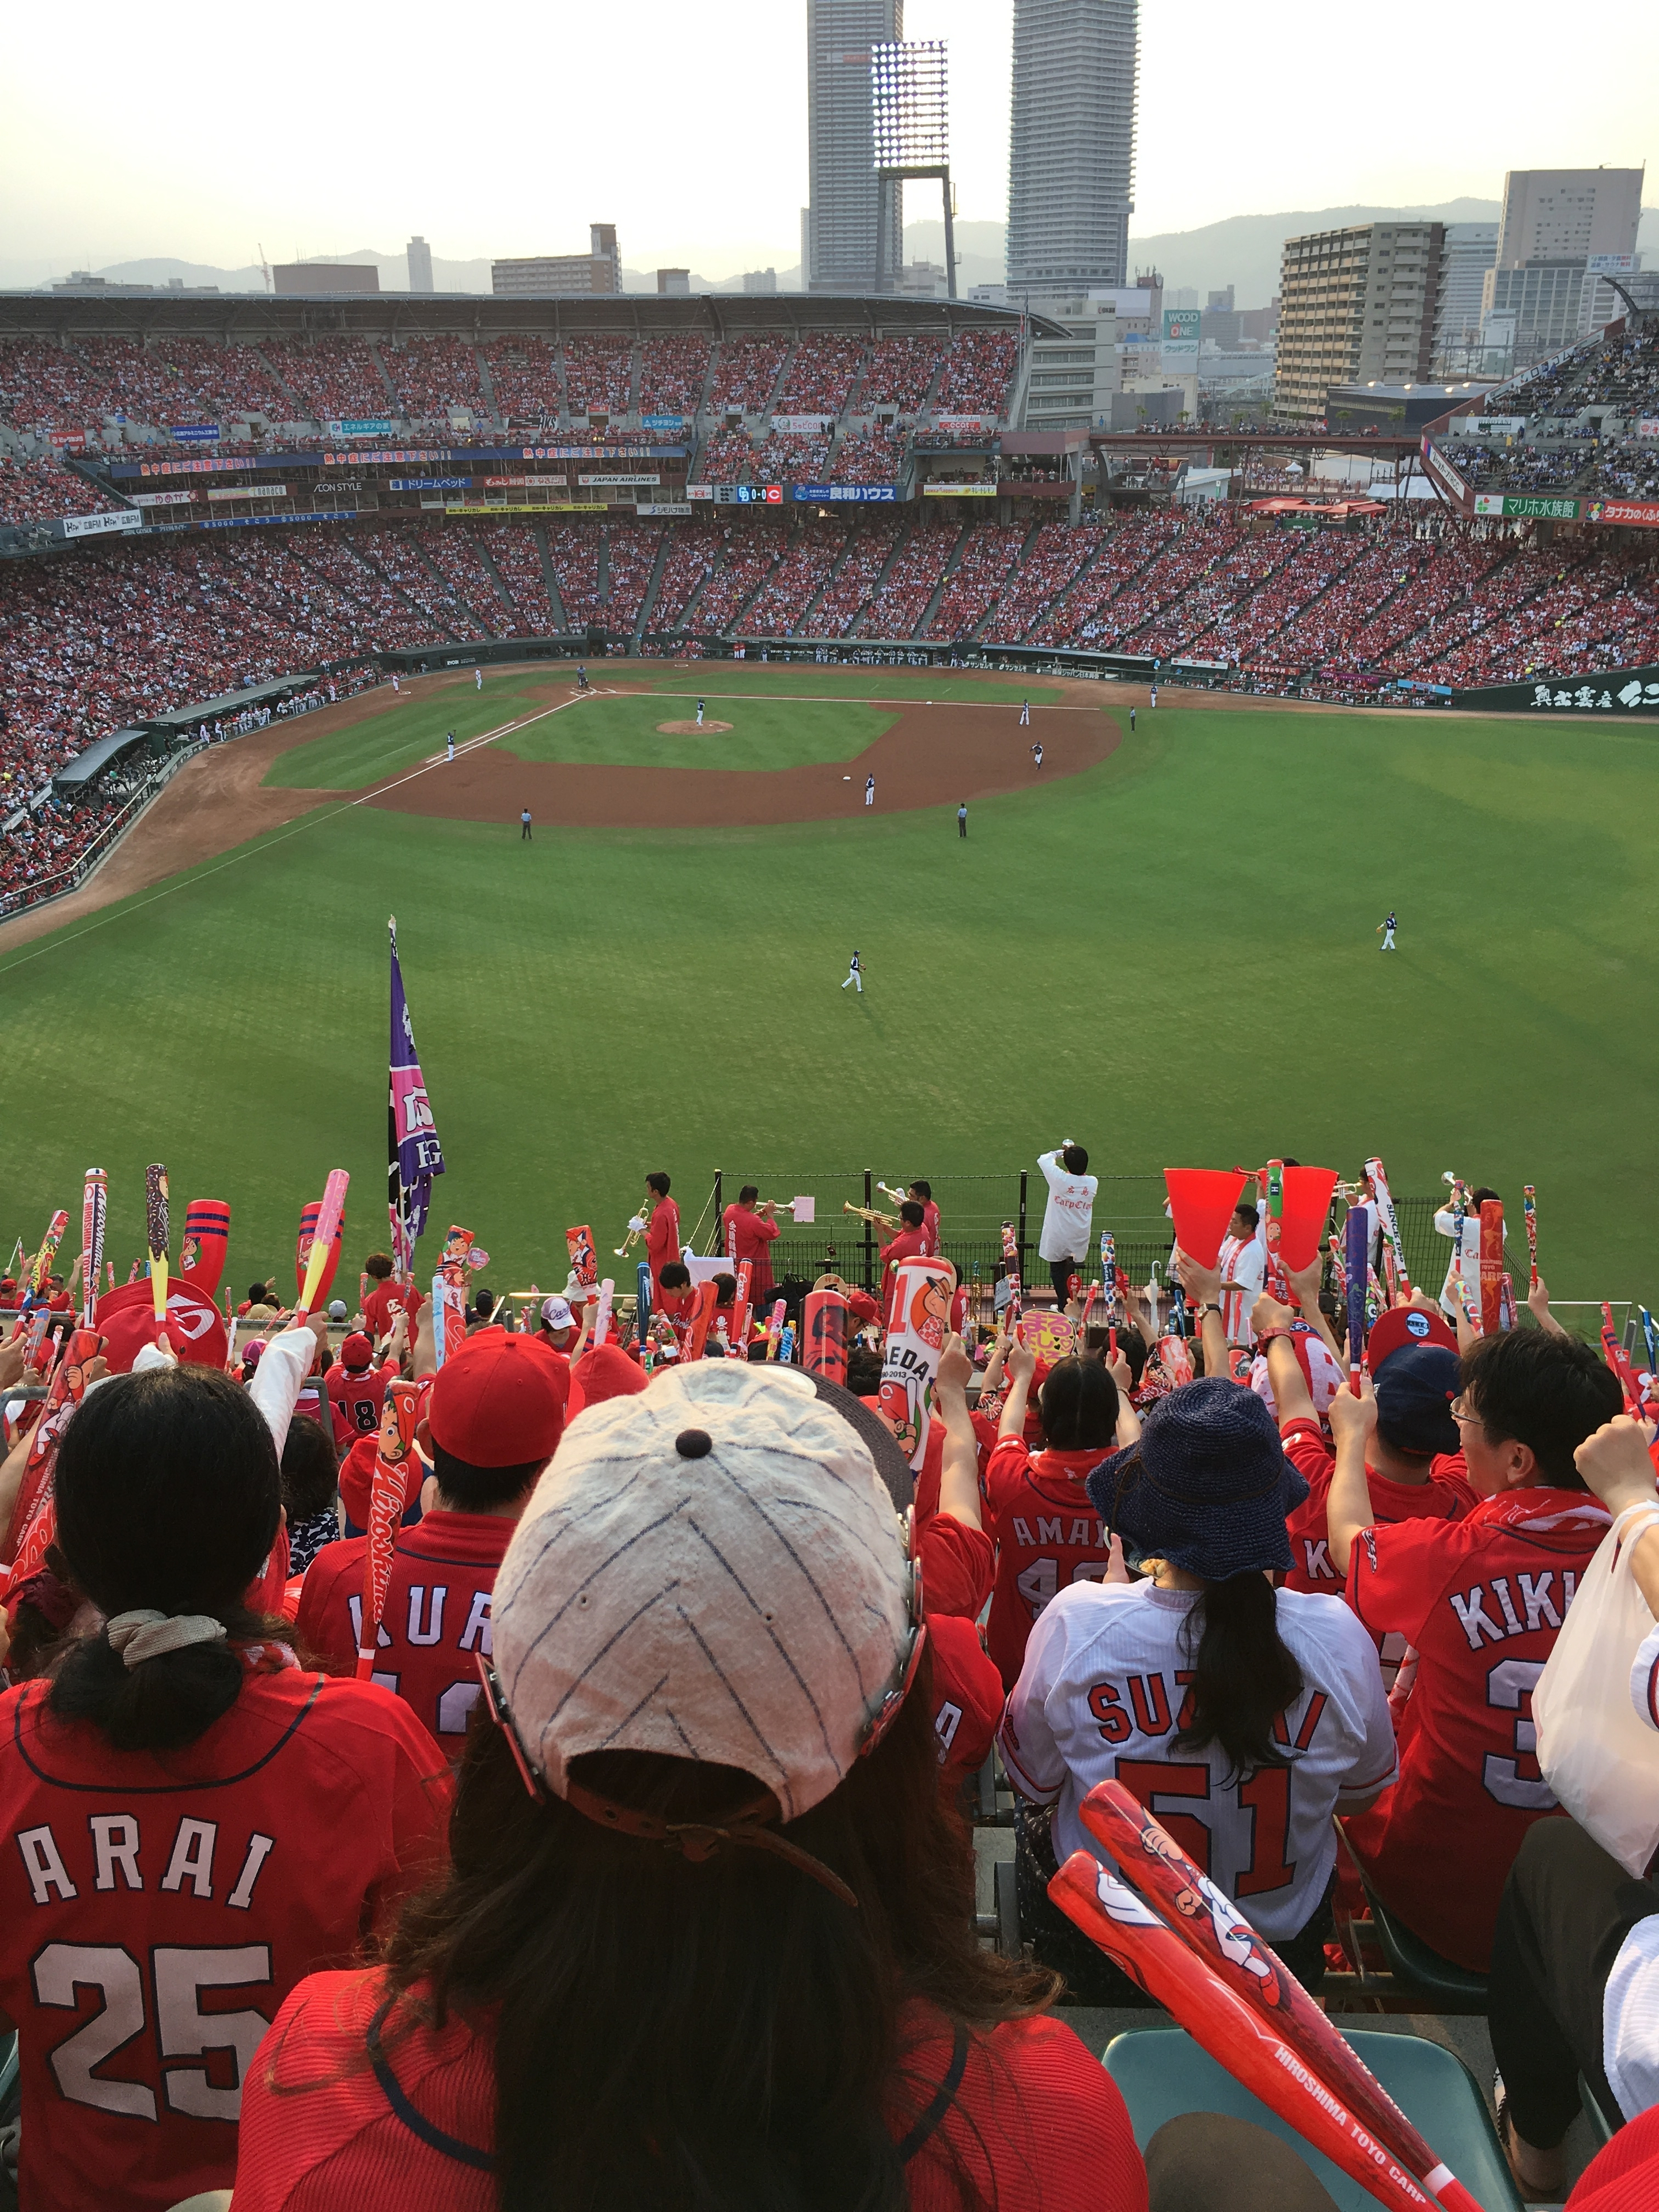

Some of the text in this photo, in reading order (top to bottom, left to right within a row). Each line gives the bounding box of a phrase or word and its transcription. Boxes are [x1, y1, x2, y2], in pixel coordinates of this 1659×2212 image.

[1168, 313, 1198, 323] WOOD
[1171, 326, 1193, 336] ONE
[1165, 345, 1198, 353] ウッドワン
[343, 422, 389, 431] エネルギアの家
[257, 486, 283, 496] nanaco
[337, 482, 362, 491] STYLE
[407, 478, 466, 488] ドリームベッド
[830, 487, 895, 500] 良和ハウス
[1508, 498, 1575, 518] マリホ水族館
[970, 662, 994, 670] サンセルモ
[1004, 664, 1027, 672] サンセルモ
[83, 1202, 93, 1251] HIROSHIMA
[1386, 1203, 1400, 1239] SINCE
[736, 1272, 748, 1302] Carp
[1022, 1311, 1072, 1337] まる
[338, 1399, 378, 1431] 18
[26, 1498, 40, 1521] TOYO
[16, 1523, 28, 1547] CARP
[1114, 1758, 1293, 1899] 51
[16, 1813, 278, 1911] ARAI
[28, 1941, 274, 2127] 25
[1274, 2046, 1427, 2205] HIROSHIMA TOYO CARP
